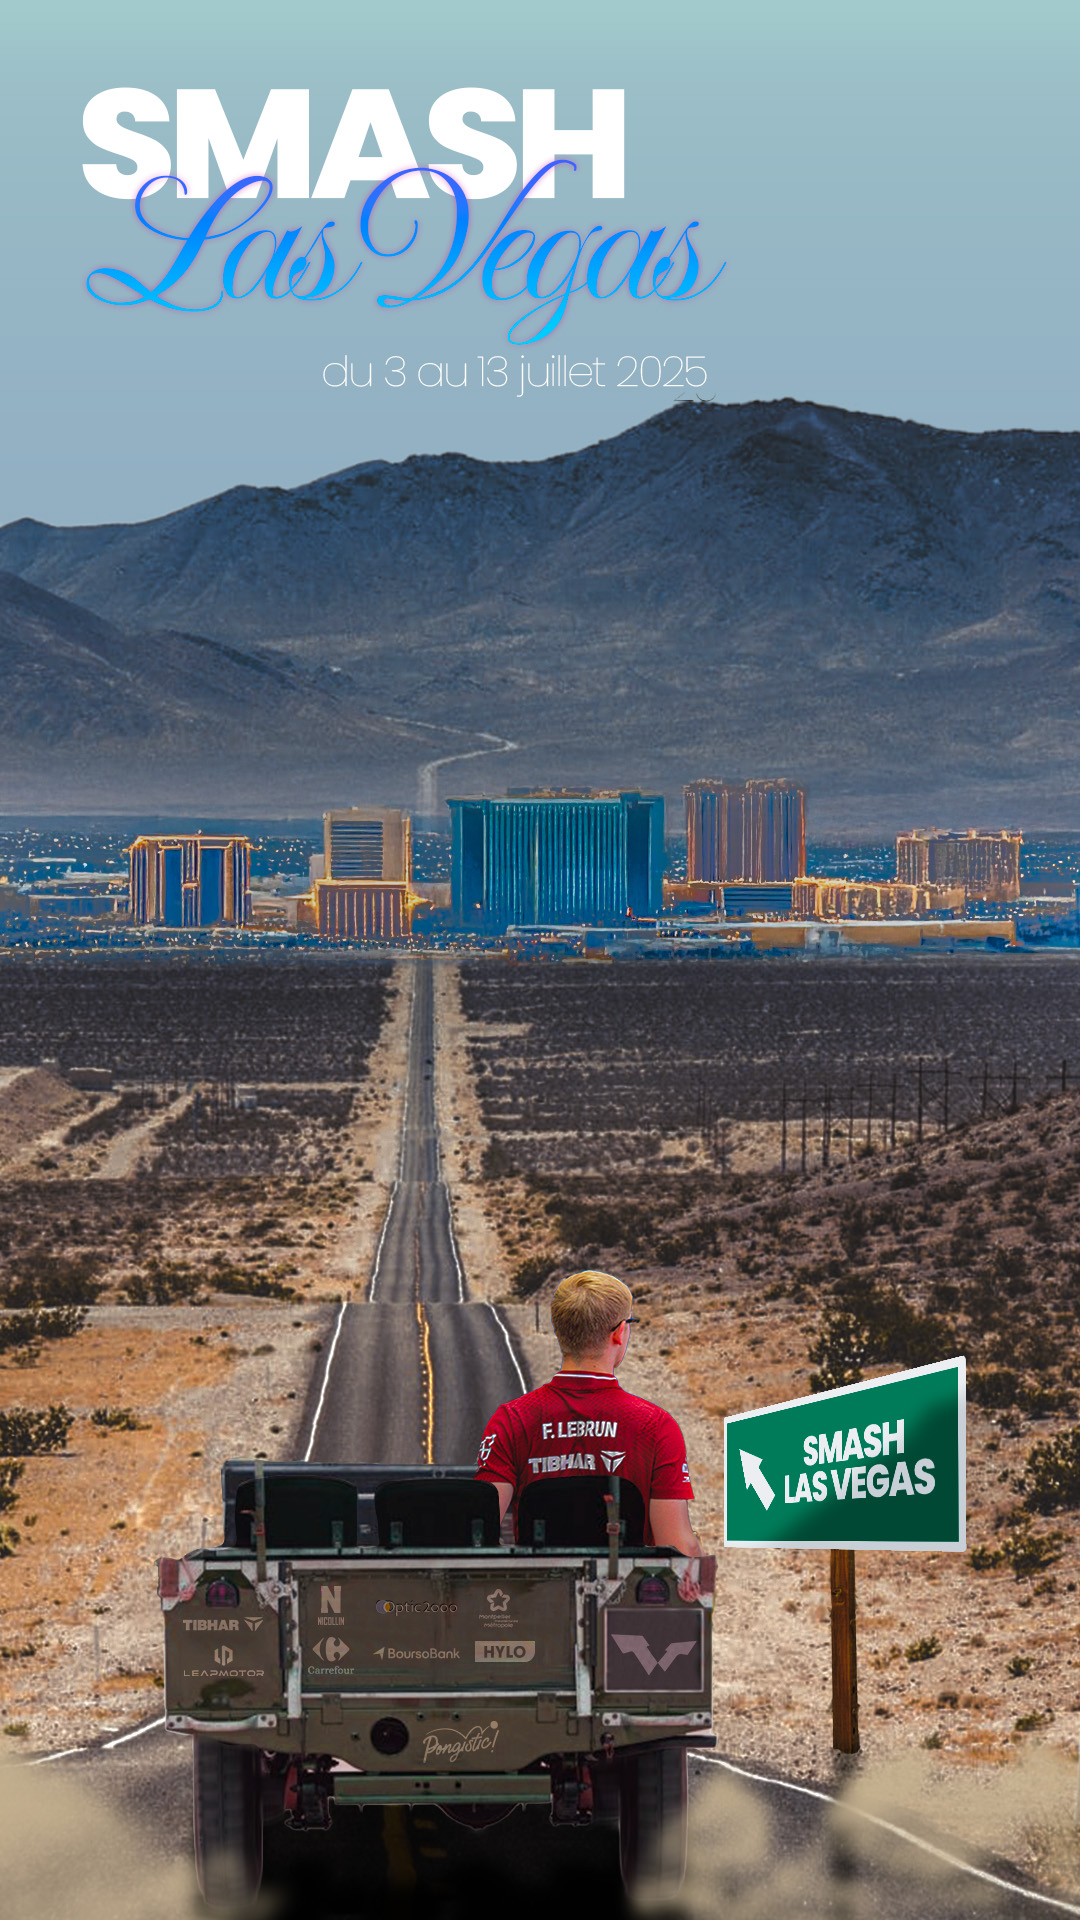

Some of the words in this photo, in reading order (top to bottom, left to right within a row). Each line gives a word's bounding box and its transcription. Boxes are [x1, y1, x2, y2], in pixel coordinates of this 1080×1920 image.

[803, 1419, 905, 1466] SMASH
[528, 1453, 596, 1473] TIBHAR
[784, 1471, 828, 1504] LAS
[830, 1458, 936, 1500] VEGAS
[384, 1599, 422, 1616] Optic
[182, 1619, 240, 1631] TIBHAR
[317, 1616, 345, 1626] NICOLLIN
[387, 1647, 461, 1660] BoursoBank
[483, 1646, 527, 1659] HYLO
[183, 1669, 265, 1677] LEAPMOTOR
[307, 1665, 355, 1675] Carrefour
[422, 1730, 500, 1764] Pongistic!
